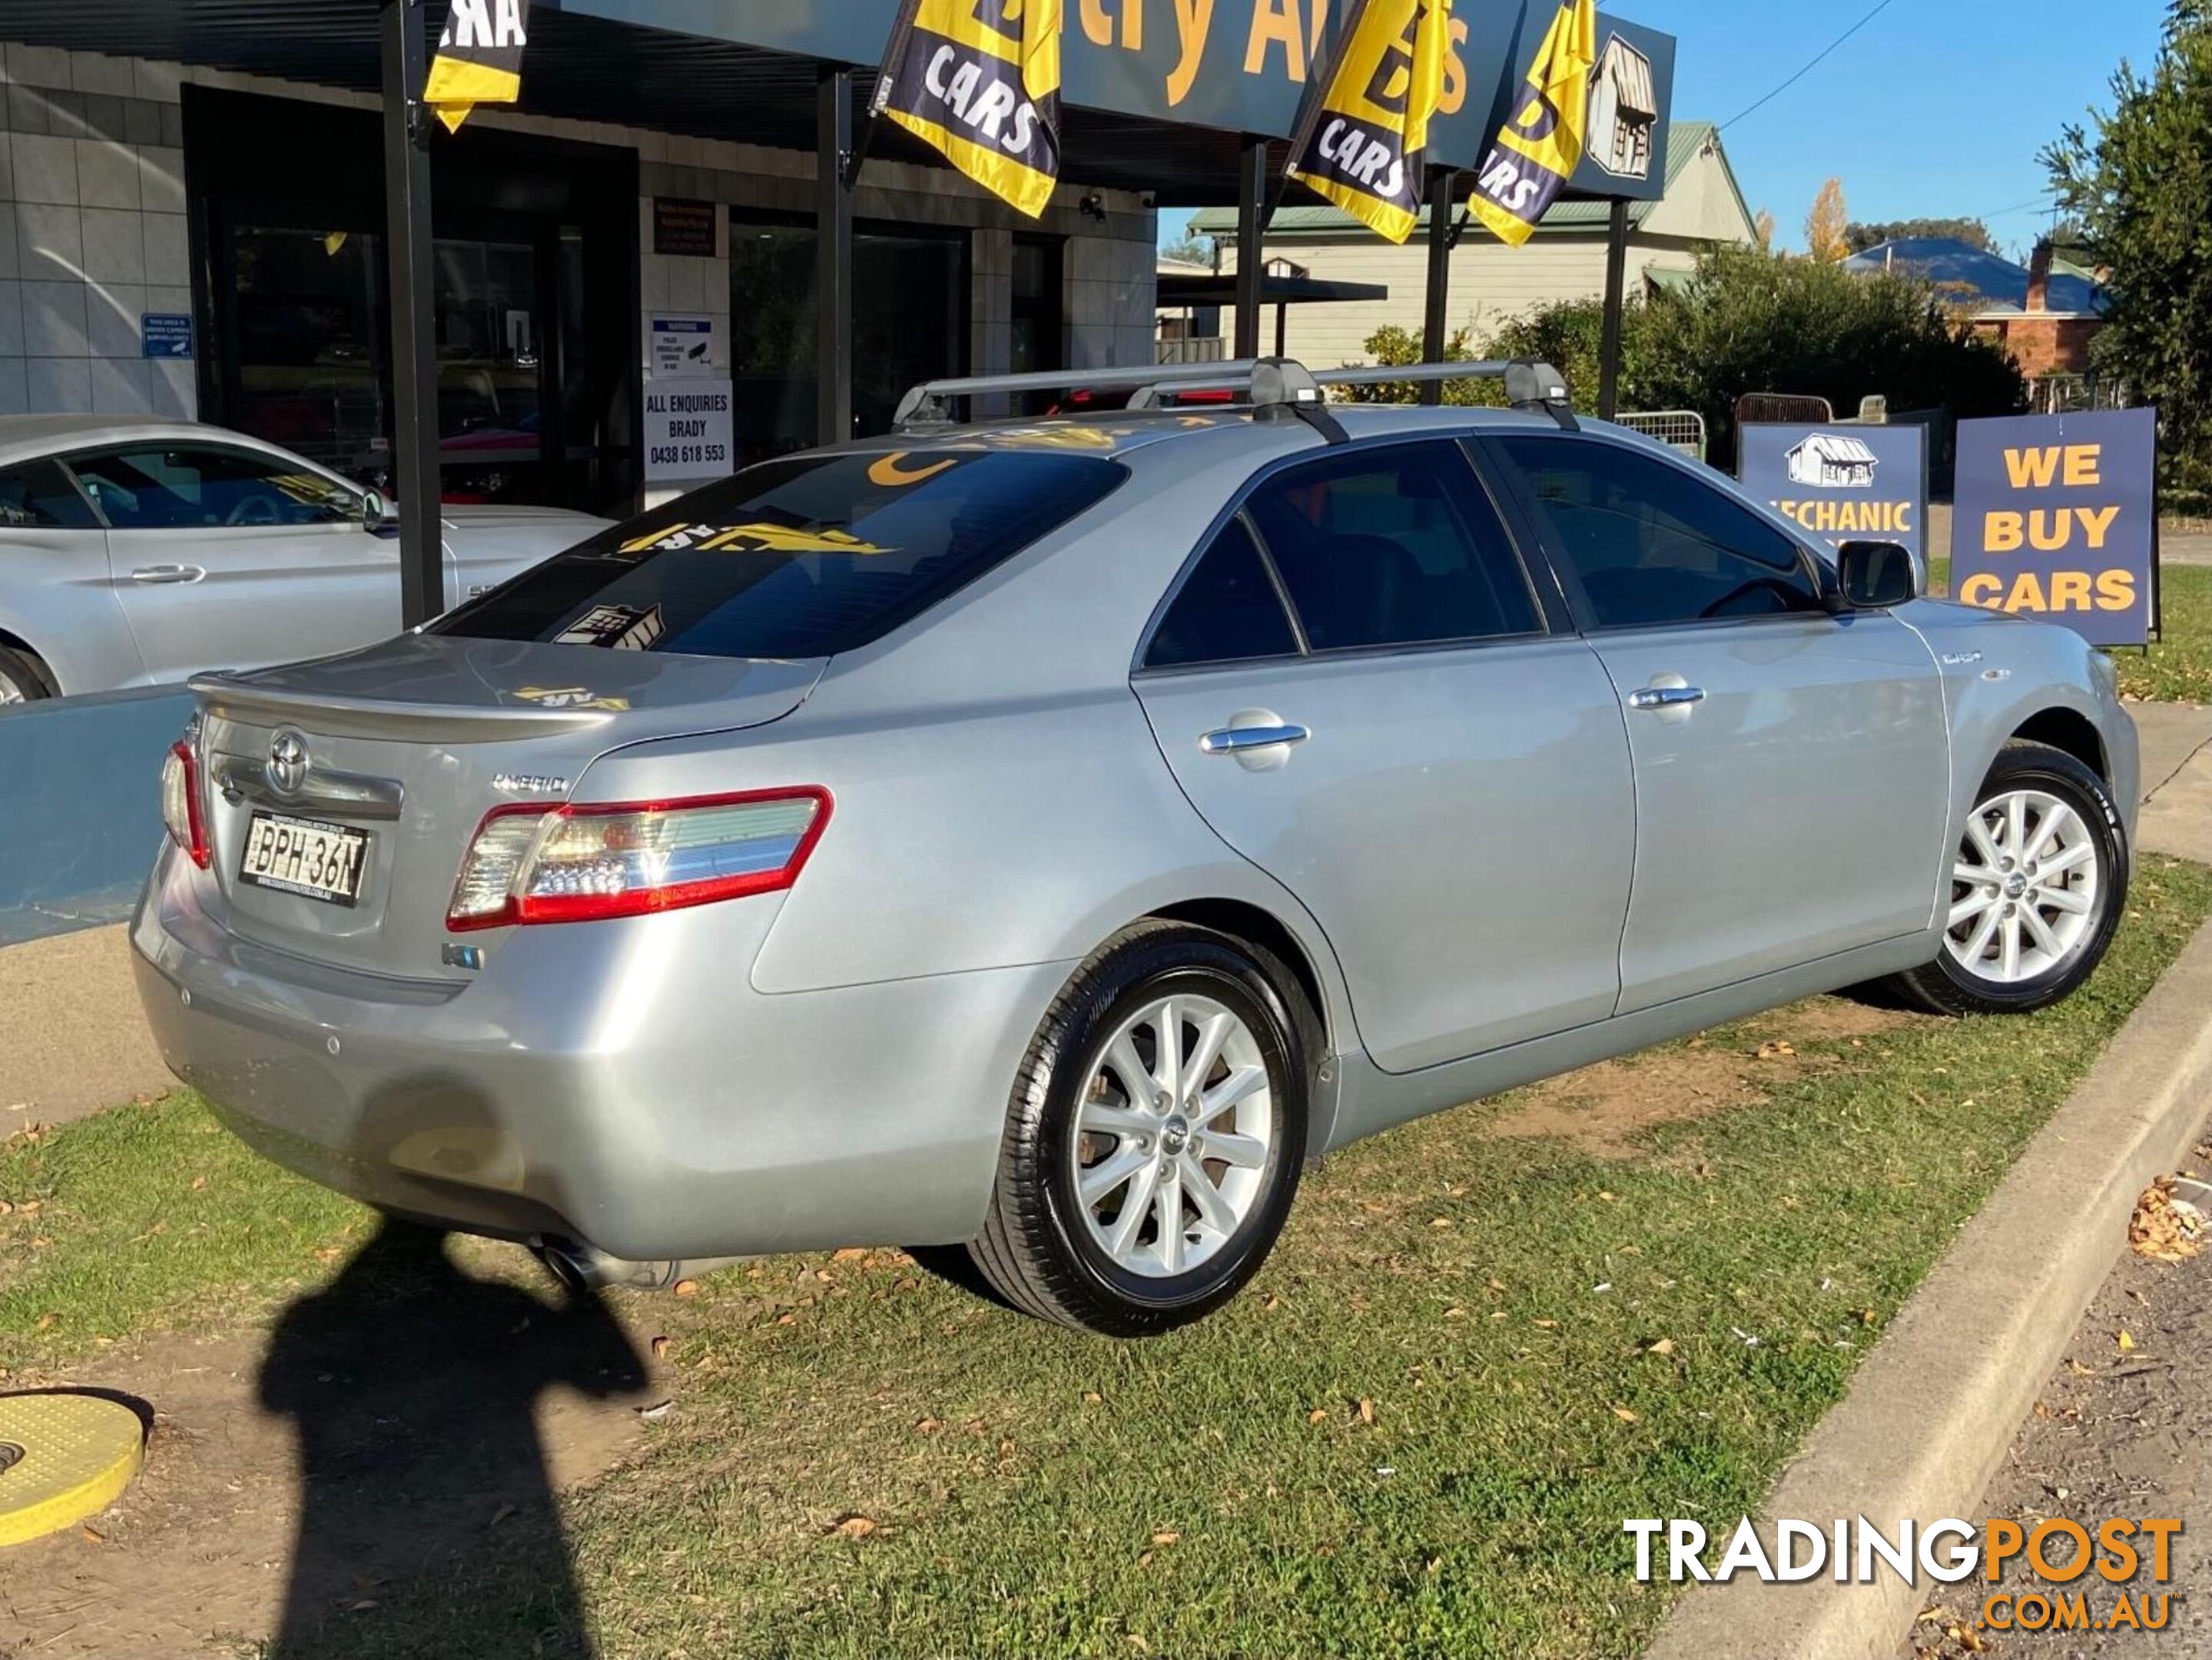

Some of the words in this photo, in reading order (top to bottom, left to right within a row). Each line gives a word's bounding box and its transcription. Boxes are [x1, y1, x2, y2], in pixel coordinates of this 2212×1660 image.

[925, 45, 1040, 154] CARS
[1318, 118, 1404, 198] CARS
[646, 395, 667, 413] ALL
[670, 394, 728, 413] ENQUIRIES
[669, 420, 706, 438] BRADY
[651, 446, 678, 464] 0438
[682, 445, 702, 463] 618
[705, 443, 725, 462] 553
[2004, 443, 2101, 488] WE
[1769, 500, 1912, 532] ECHANIC
[1984, 506, 2121, 552] BUY
[1960, 569, 2136, 613] CARS
